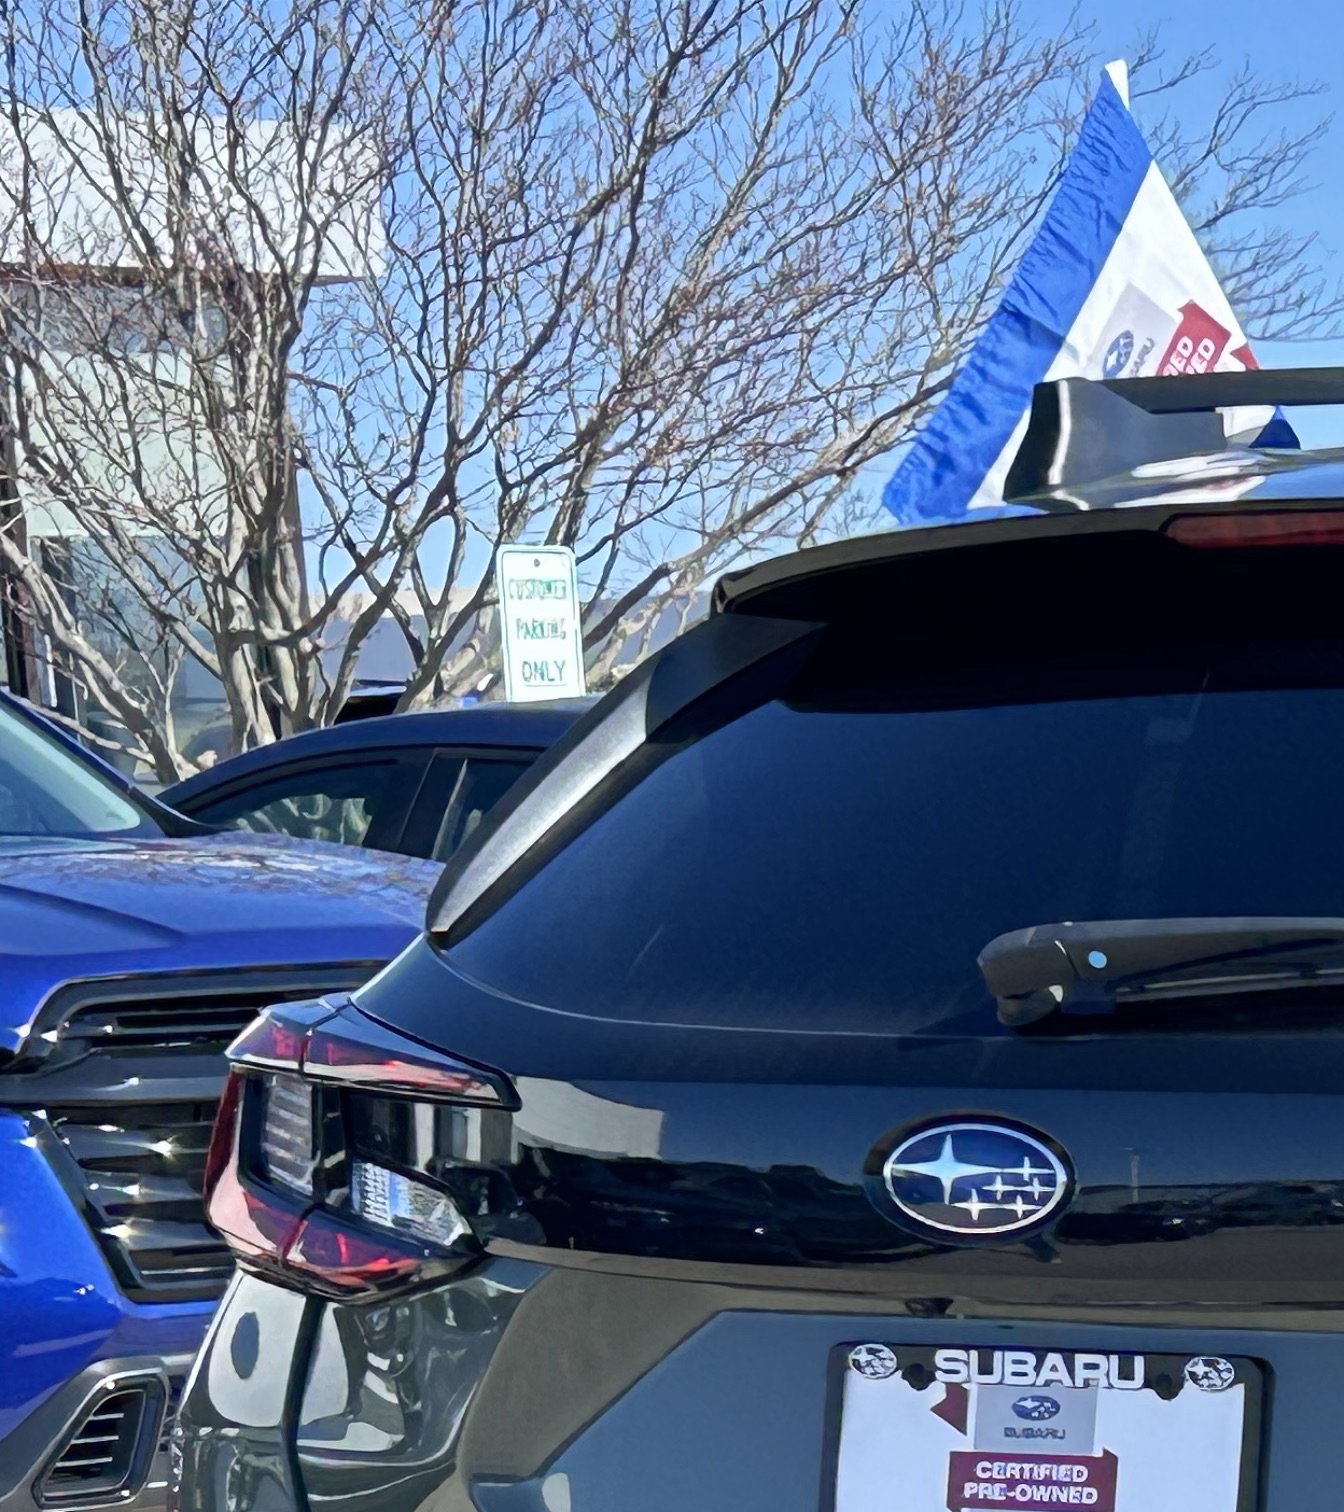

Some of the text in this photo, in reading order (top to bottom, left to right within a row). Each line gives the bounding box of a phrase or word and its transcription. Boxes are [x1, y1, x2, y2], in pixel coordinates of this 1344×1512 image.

[521, 659, 567, 683] ONLY
[934, 1348, 1145, 1390] SUBARU
[1003, 1426, 1066, 1441] SUBARU
[974, 1459, 1089, 1483] CERTIFIED
[963, 1482, 1099, 1505] PRE-OWNED
